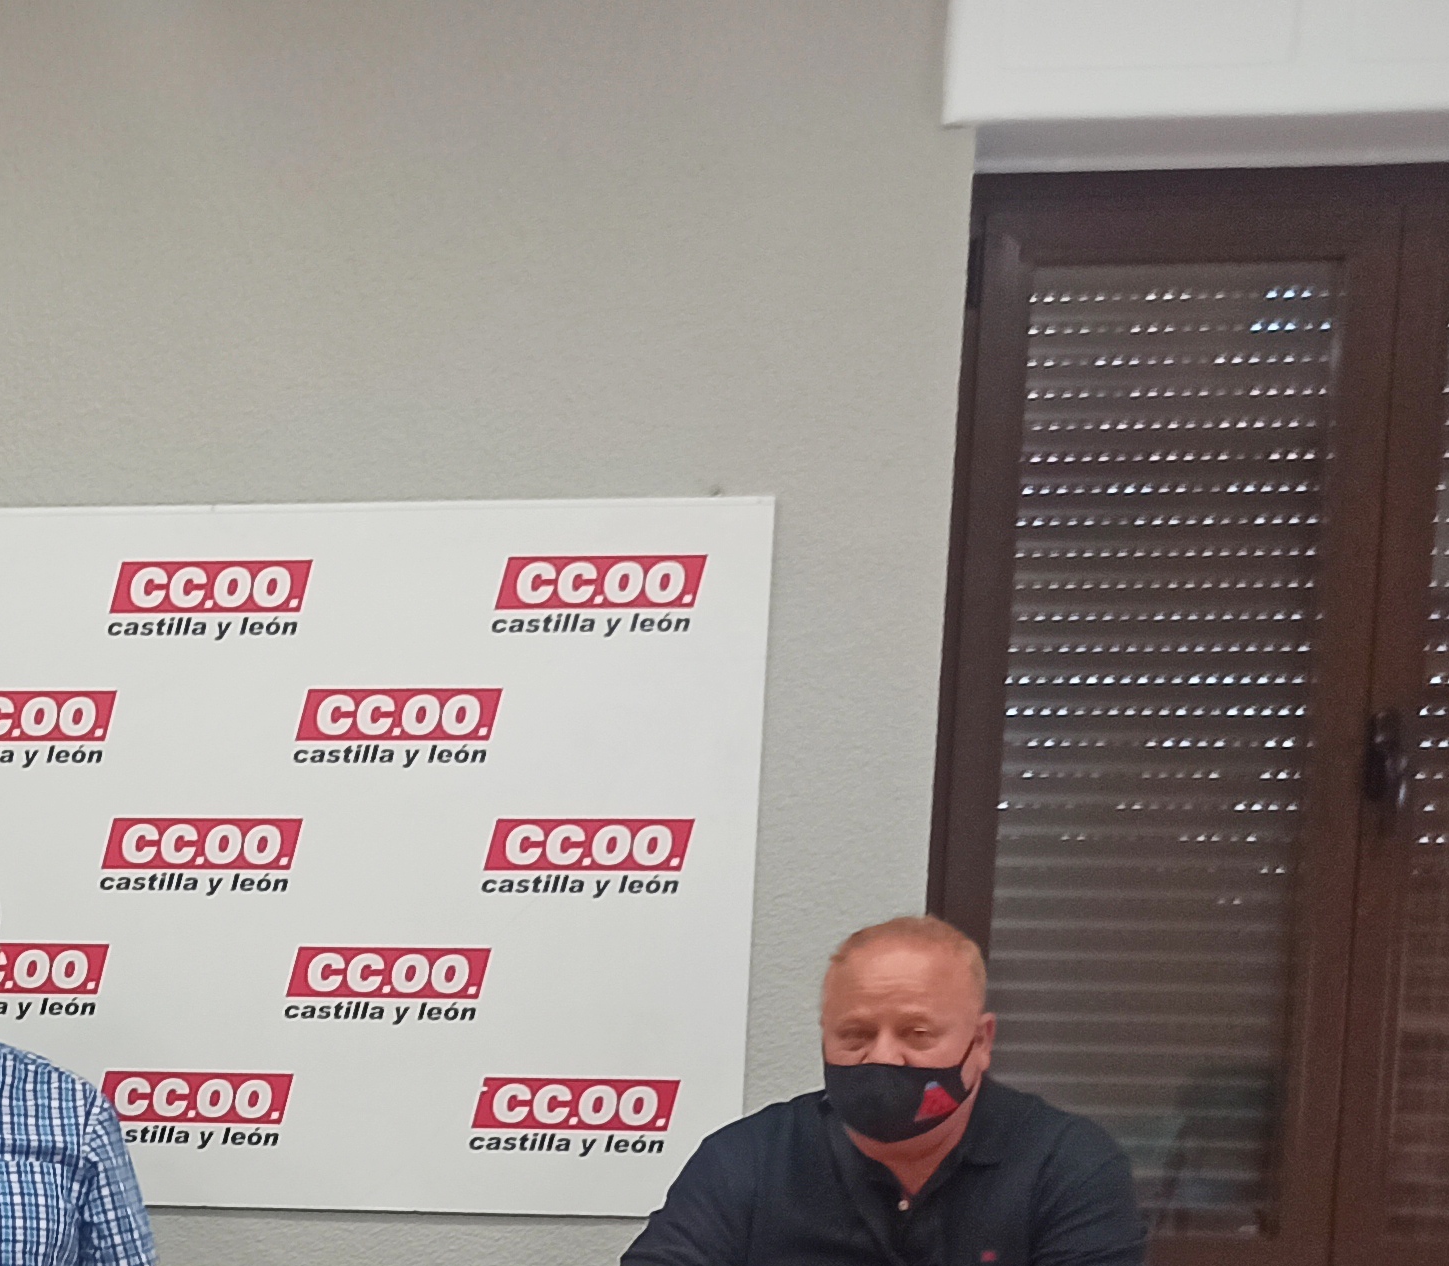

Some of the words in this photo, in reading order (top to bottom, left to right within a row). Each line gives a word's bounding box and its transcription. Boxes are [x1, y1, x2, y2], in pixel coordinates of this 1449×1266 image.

[130, 566, 299, 608] CC.OO.
[517, 561, 692, 604] CC.OO.
[108, 618, 206, 635] castilla
[216, 622, 231, 640] y
[240, 617, 297, 635] león
[492, 614, 595, 633] castilla
[605, 618, 621, 636] y
[631, 614, 689, 632] león
[317, 694, 488, 736] CC.OO.
[23, 750, 38, 768] y
[47, 746, 102, 763] león
[294, 745, 394, 763] castilla
[403, 750, 419, 768] y
[428, 745, 486, 763] león
[122, 824, 289, 865] CC.OO.
[506, 824, 680, 866] CC.OO.
[100, 873, 198, 890] castilla
[207, 878, 222, 896] y
[231, 874, 288, 891] león
[482, 875, 584, 893] castilla
[593, 880, 610, 898] y
[619, 875, 678, 893] león
[308, 953, 477, 994] CC.OO.
[16, 1002, 32, 1020] y
[40, 997, 95, 1015] león
[285, 1001, 384, 1019] castilla
[393, 1007, 409, 1024] y
[418, 1002, 476, 1020] león
[114, 1077, 280, 1119] CC.OO.
[493, 1084, 665, 1126] CC.OO.
[125, 1126, 189, 1143] stilla
[198, 1131, 213, 1149] y
[222, 1127, 279, 1146] león
[469, 1133, 570, 1151] castilla
[579, 1139, 596, 1157] y
[605, 1135, 664, 1153] león
